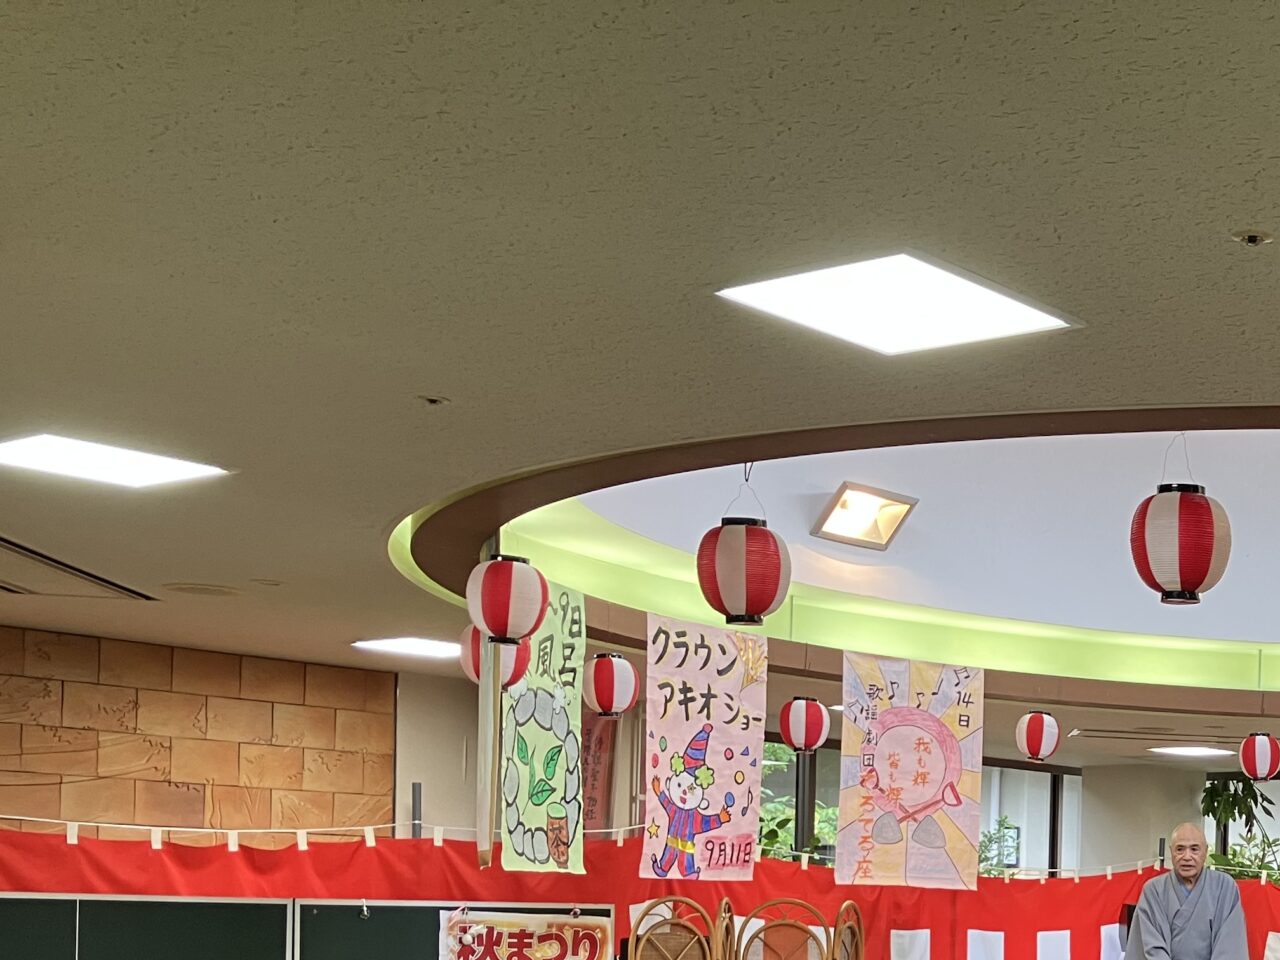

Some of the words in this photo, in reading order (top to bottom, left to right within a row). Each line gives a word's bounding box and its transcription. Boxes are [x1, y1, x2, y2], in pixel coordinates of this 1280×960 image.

[535, 633, 577, 688] 風呂
[652, 626, 738, 676] クラウン
[705, 840, 751, 867] 9月11日
